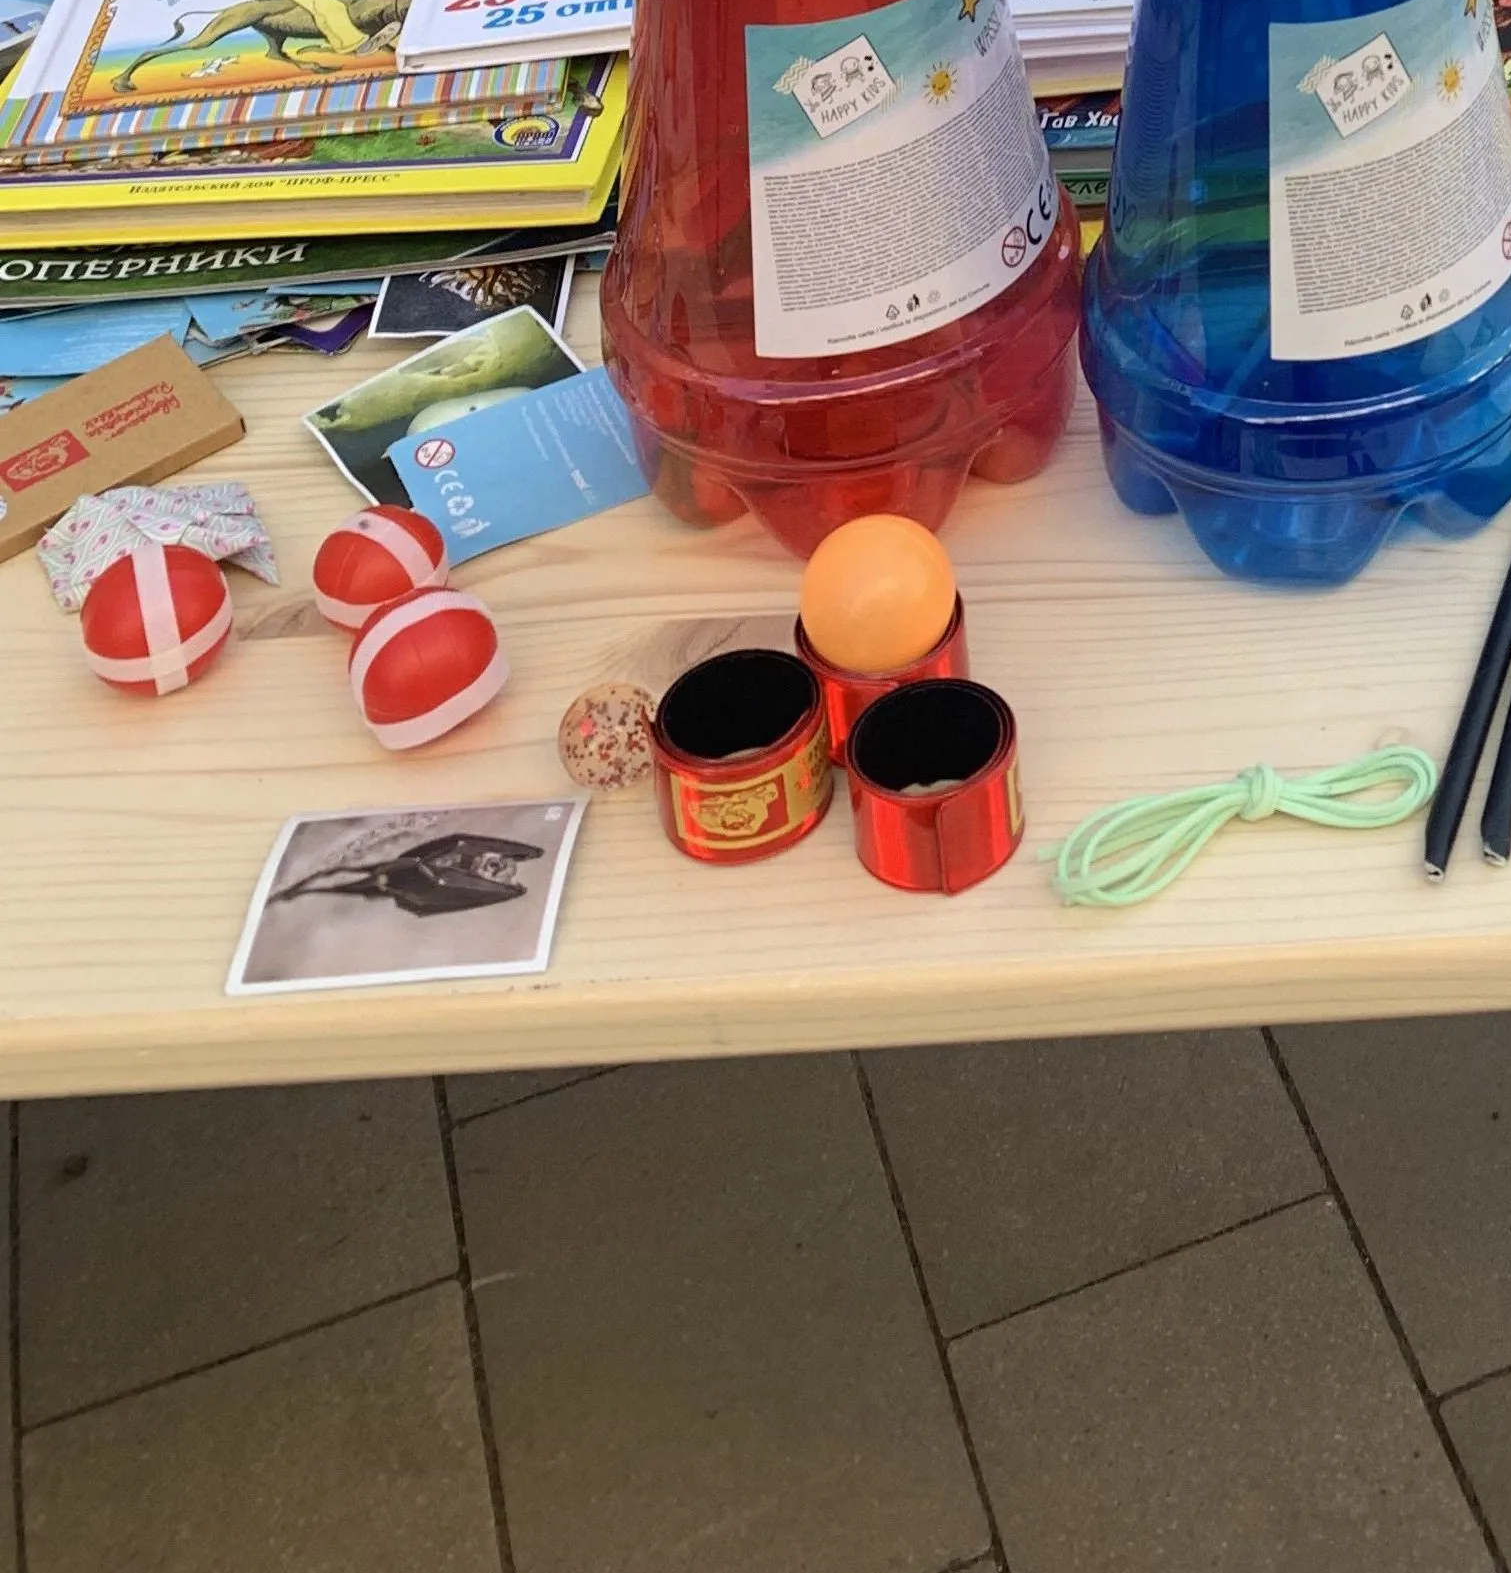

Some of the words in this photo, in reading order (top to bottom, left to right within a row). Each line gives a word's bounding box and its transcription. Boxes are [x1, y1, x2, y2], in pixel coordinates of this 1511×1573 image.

[481, 1, 549, 29] 25
[820, 98, 859, 125] HAPPY
[861, 76, 887, 104] KIDS
[1342, 96, 1379, 124] HAPPY
[128, 179, 240, 194] Издательский
[243, 179, 274, 190] дом
[0, 243, 311, 281] ОПЕРНИКИ
